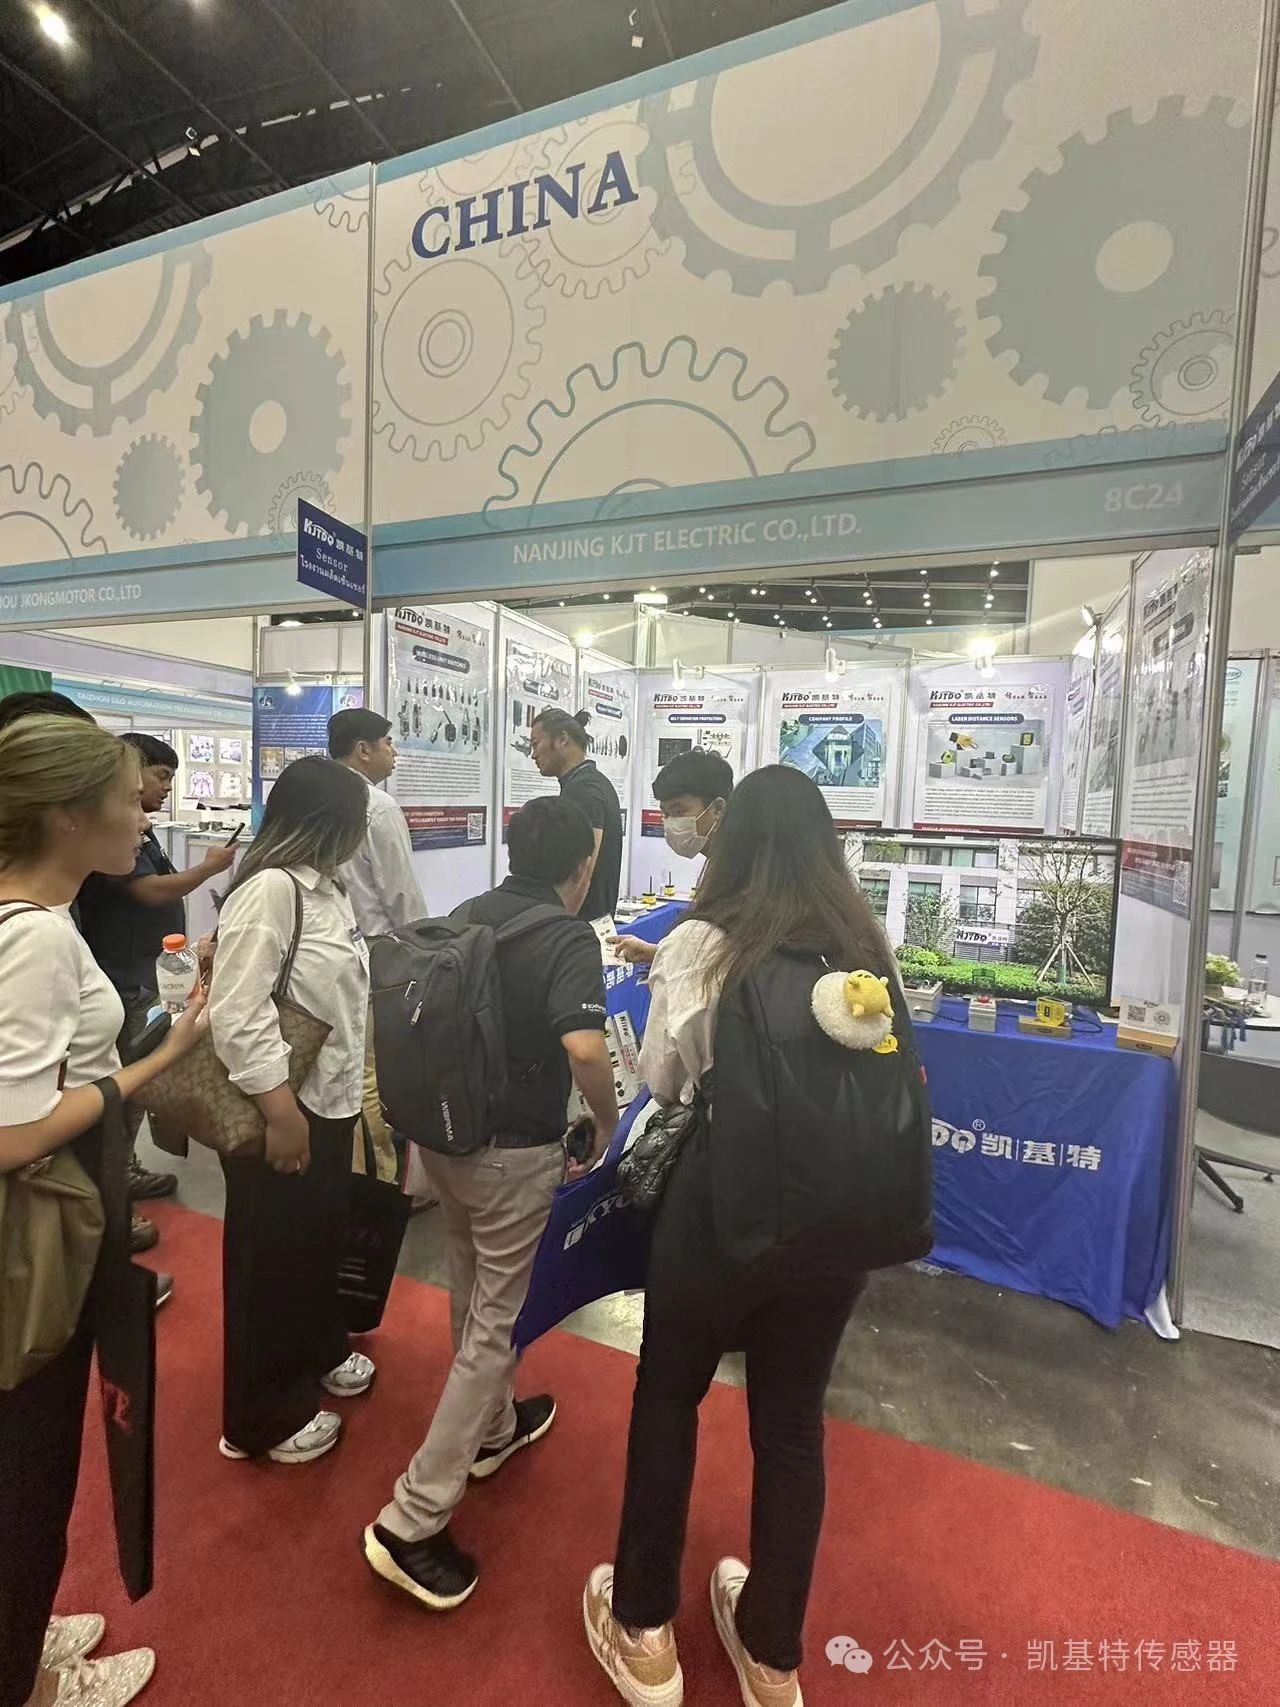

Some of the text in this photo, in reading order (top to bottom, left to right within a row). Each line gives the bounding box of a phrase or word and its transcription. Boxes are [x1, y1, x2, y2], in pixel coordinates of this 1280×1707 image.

[411, 150, 639, 259] CHINA
[1104, 482, 1185, 512] 8C24
[316, 547, 349, 573] Sensor
[513, 537, 604, 565] NANJING
[611, 533, 647, 556] KJT
[653, 521, 756, 552] ELECTRIC
